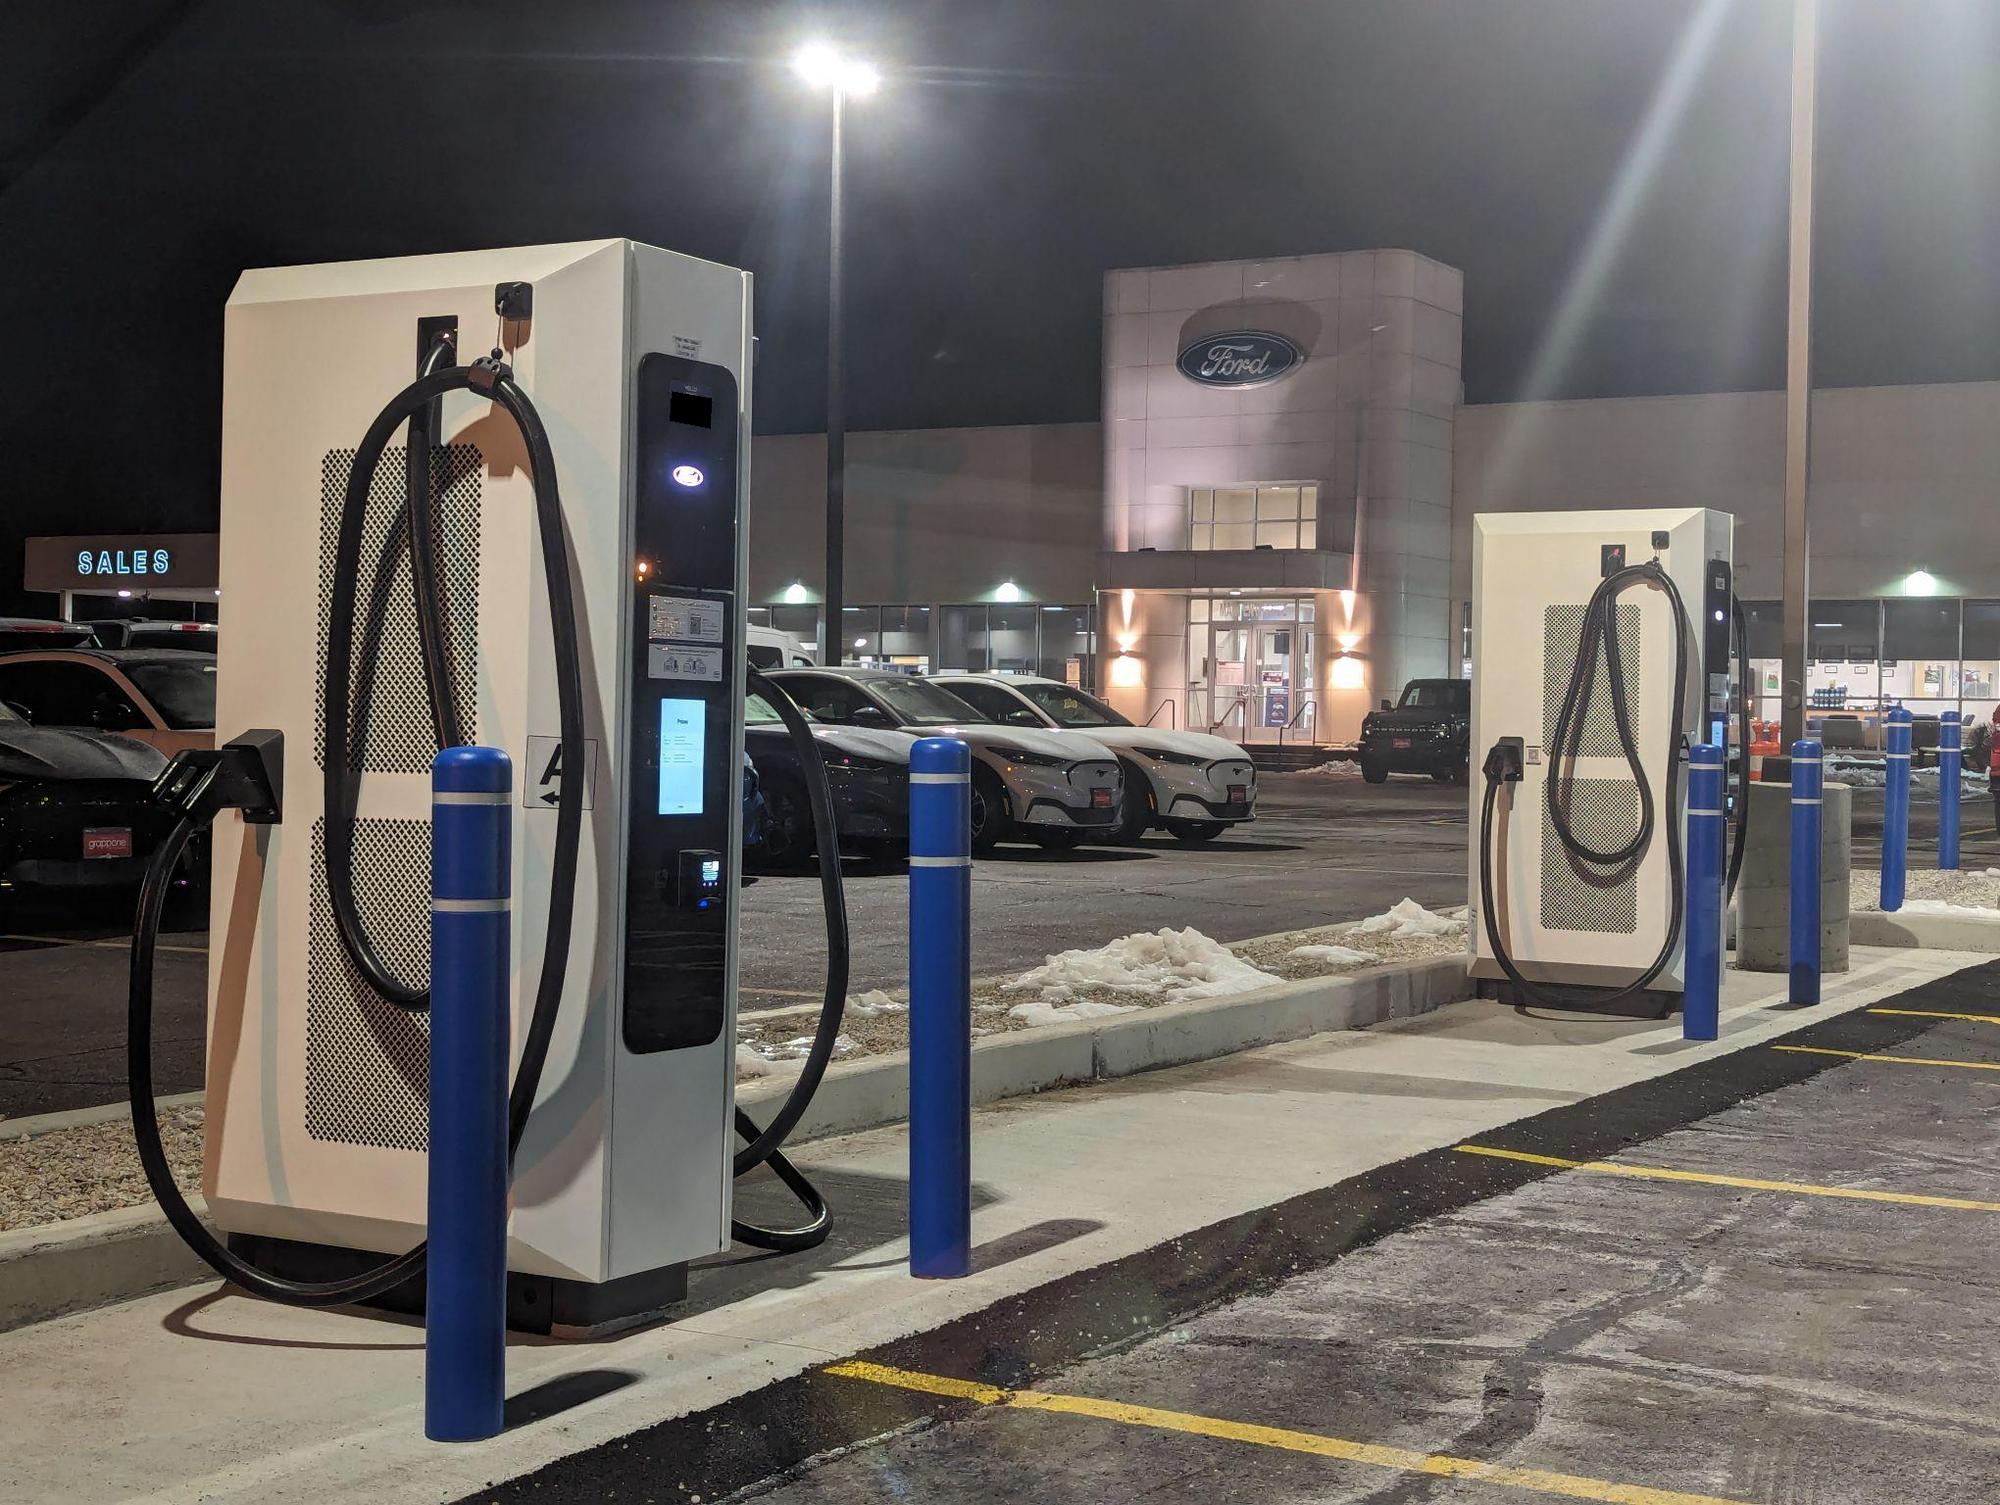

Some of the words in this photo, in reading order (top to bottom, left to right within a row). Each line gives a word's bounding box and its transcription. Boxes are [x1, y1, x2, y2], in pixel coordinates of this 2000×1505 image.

[1199, 344, 1272, 376] Ford
[78, 549, 169, 575] SALES
[88, 839, 127, 850] grappone
